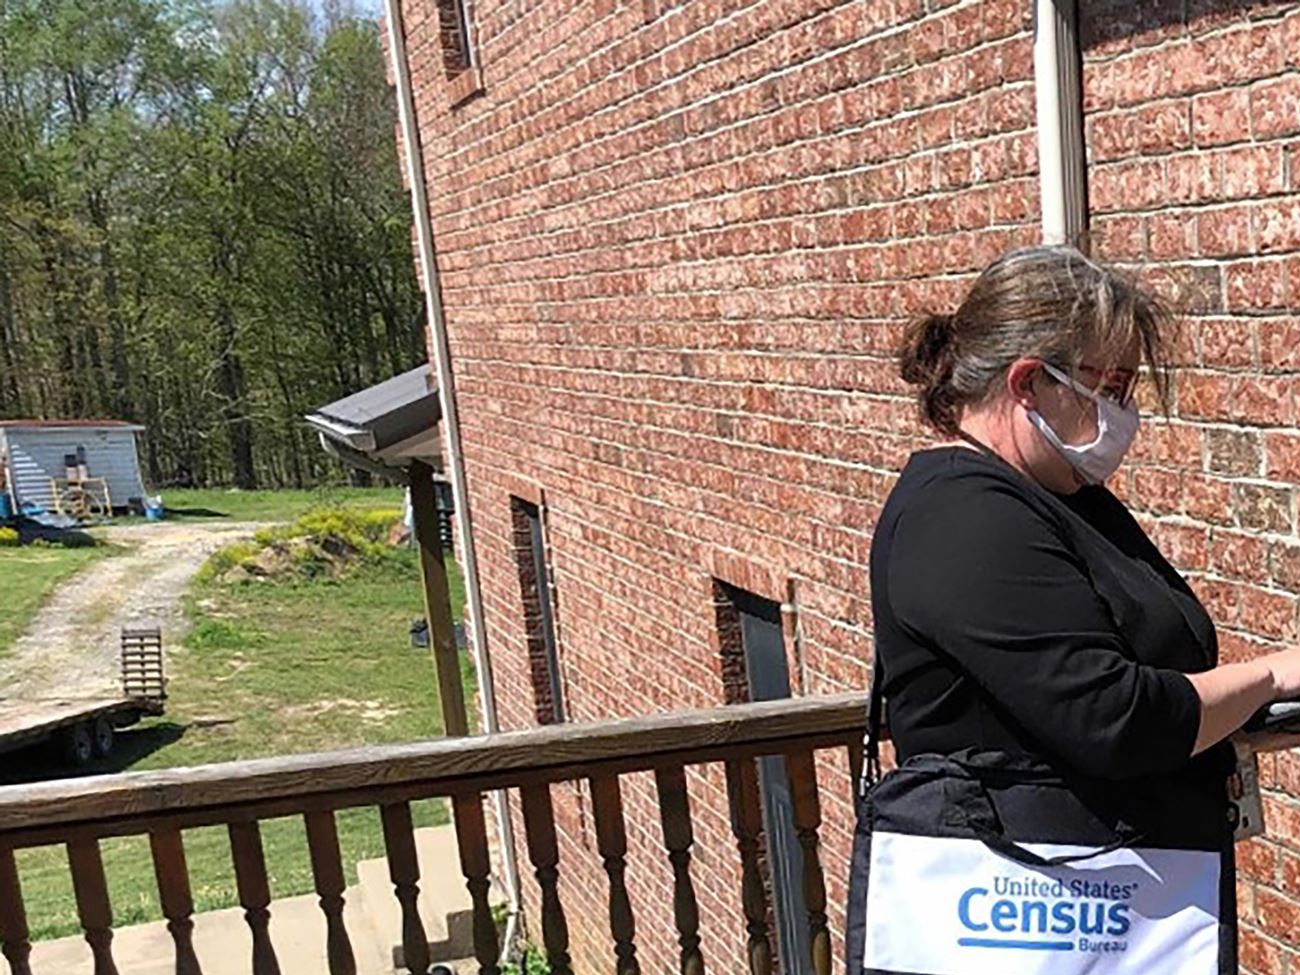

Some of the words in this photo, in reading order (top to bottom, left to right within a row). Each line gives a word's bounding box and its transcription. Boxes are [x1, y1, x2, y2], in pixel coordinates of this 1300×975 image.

[993, 876, 1063, 898] United
[1070, 879, 1132, 900] States
[957, 887, 1132, 936] Census
[1078, 937, 1129, 952] Bureau
